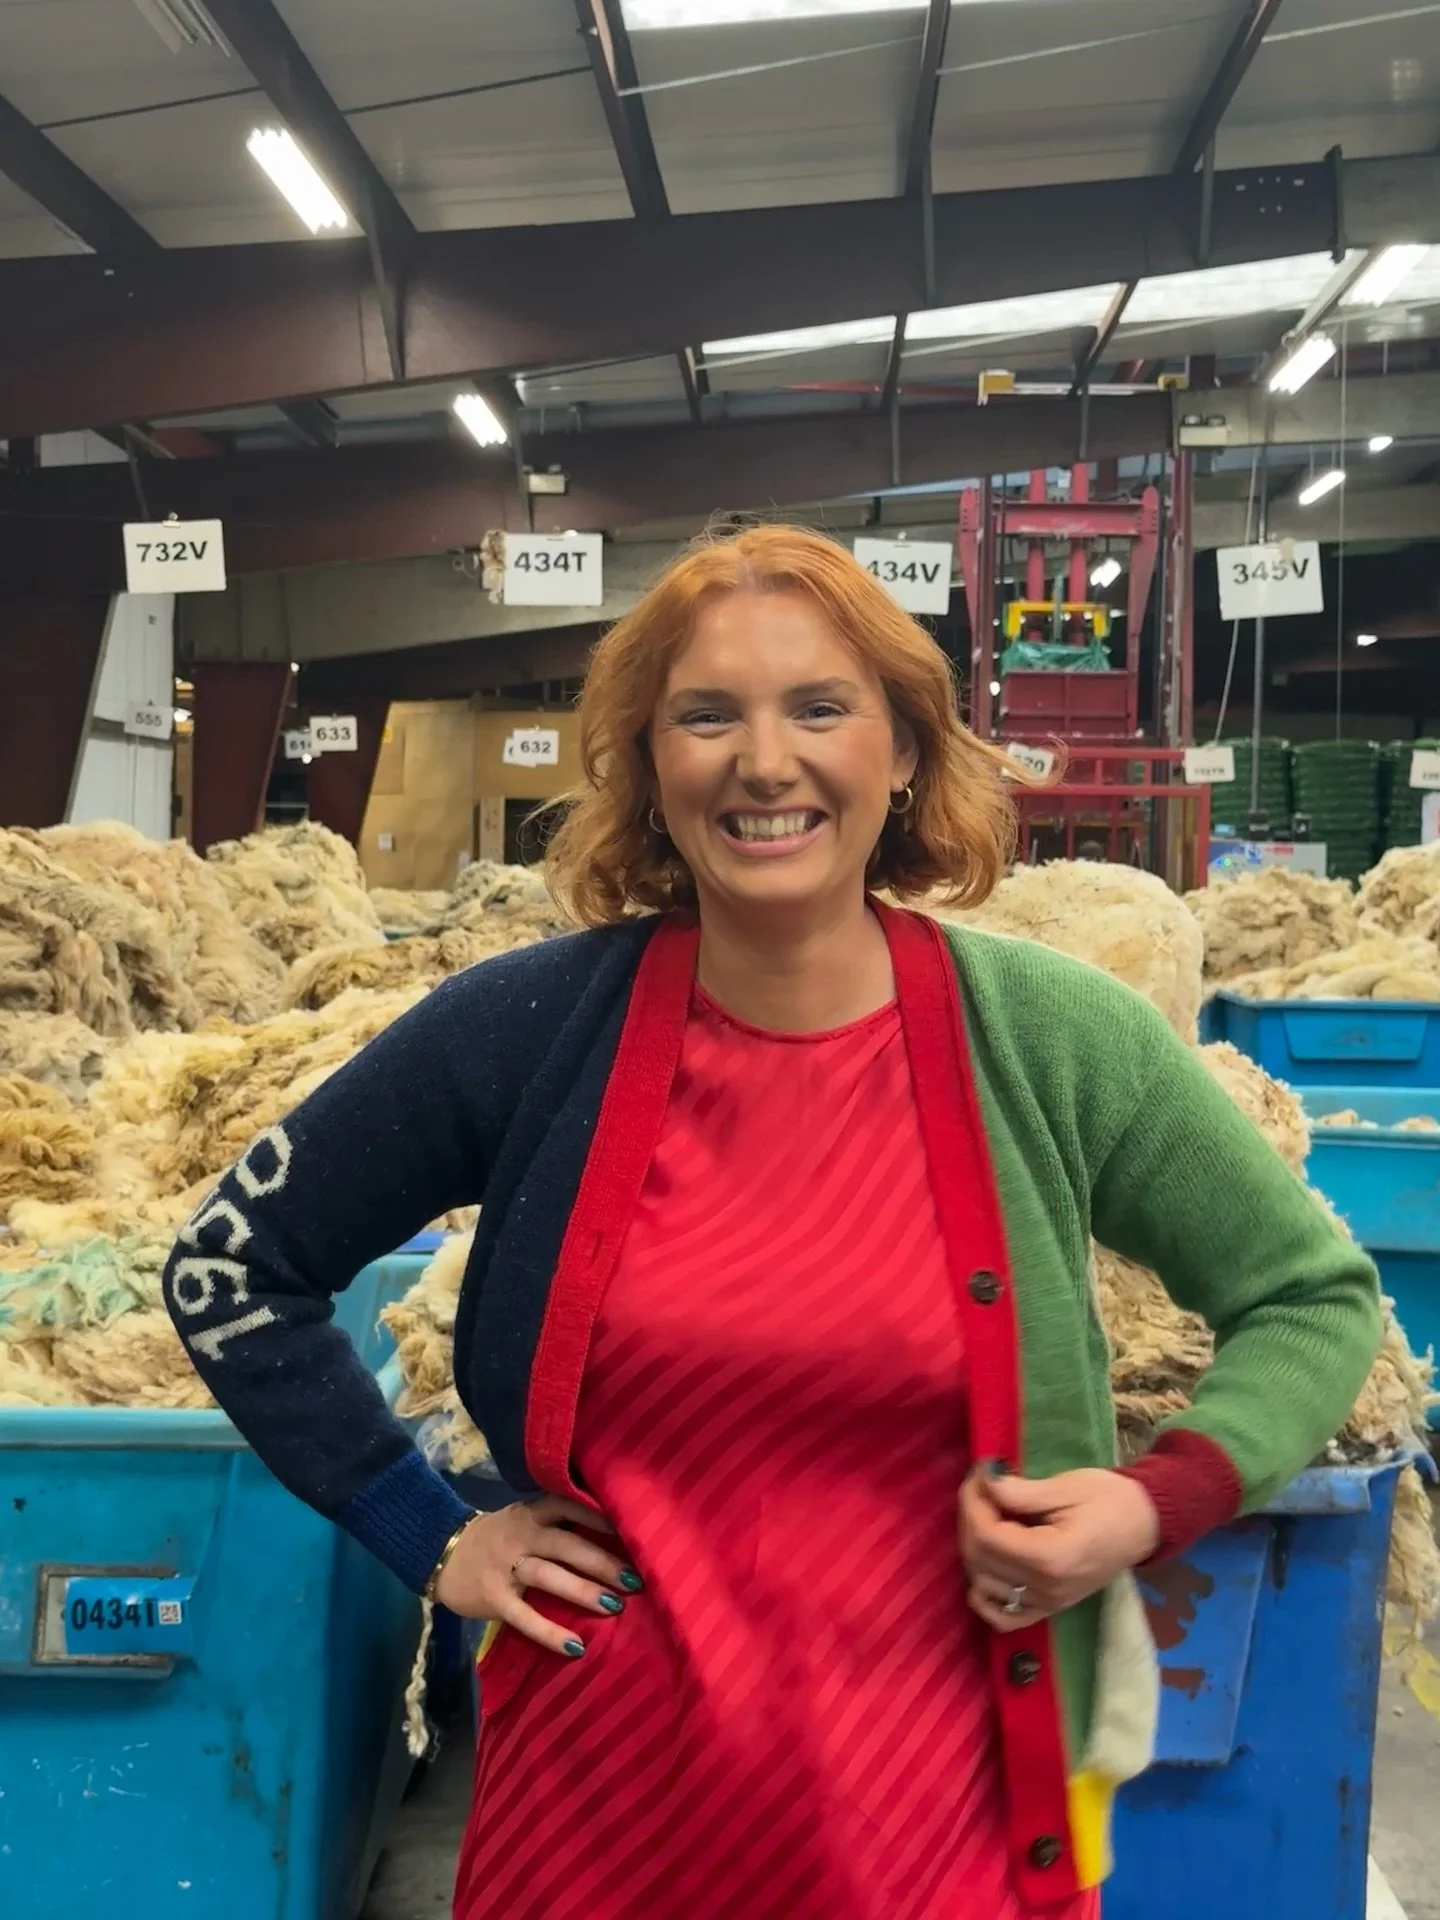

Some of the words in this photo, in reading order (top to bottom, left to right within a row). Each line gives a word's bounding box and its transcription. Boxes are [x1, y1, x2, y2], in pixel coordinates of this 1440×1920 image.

[135, 540, 209, 564] 732V
[513, 551, 588, 575] 434T
[867, 560, 941, 584] 434V
[1232, 558, 1310, 585] 345V
[316, 727, 351, 741] 633
[520, 740, 552, 754] 632
[172, 1124, 293, 1361] 1950
